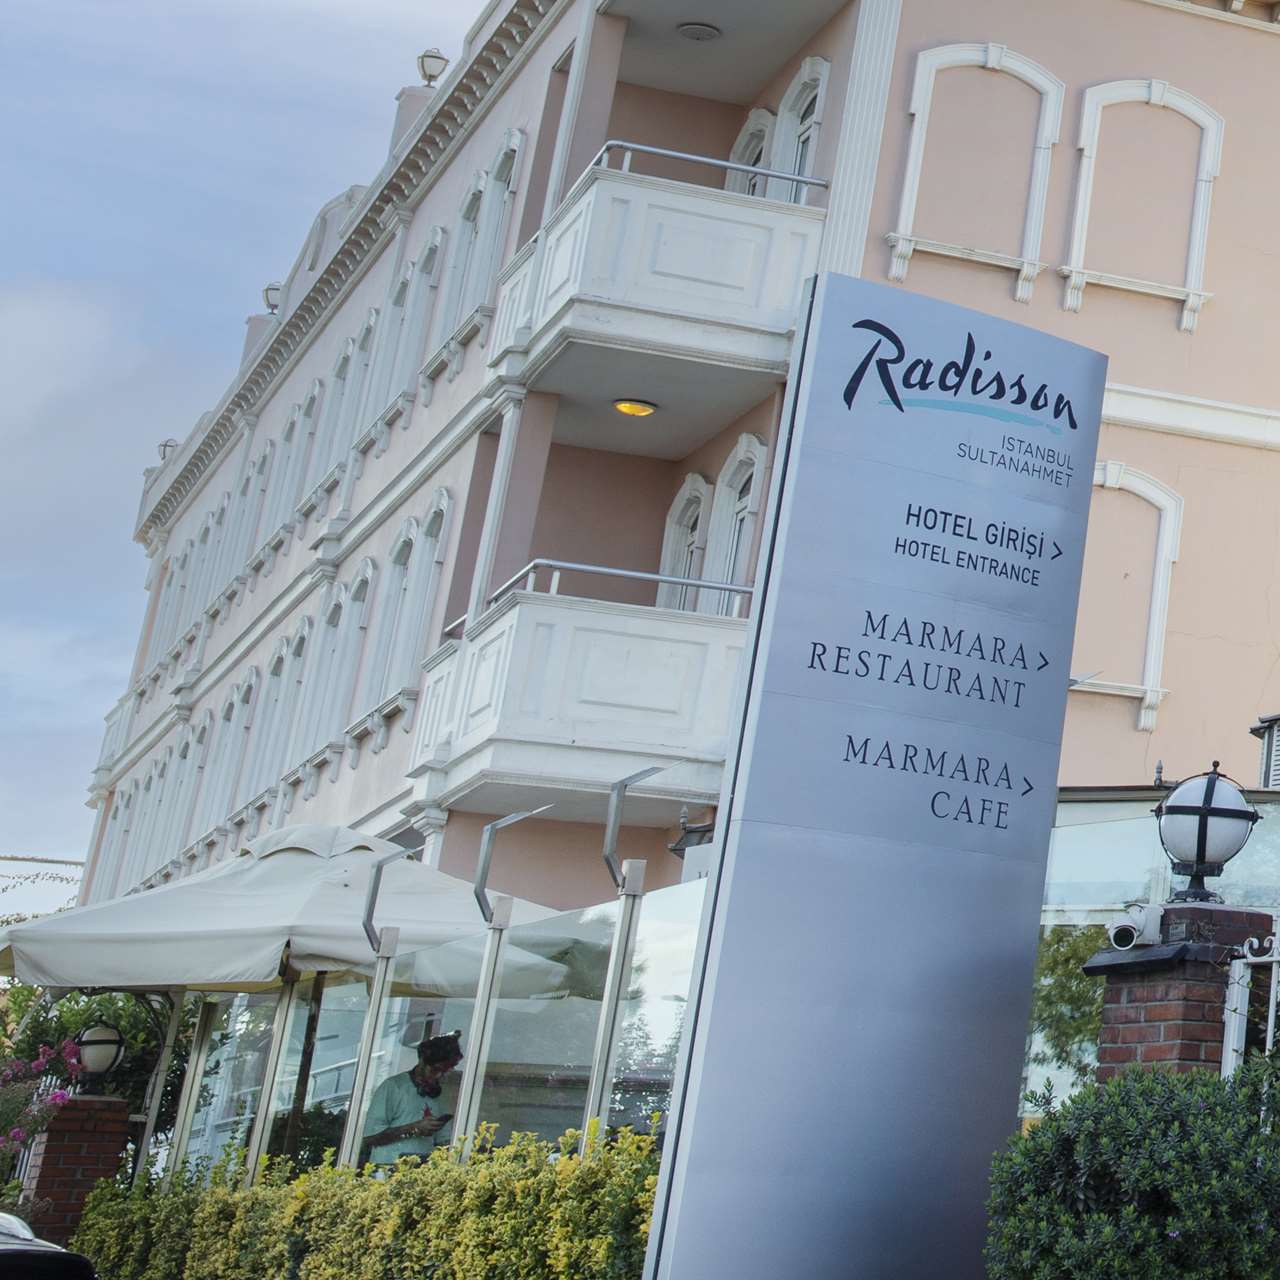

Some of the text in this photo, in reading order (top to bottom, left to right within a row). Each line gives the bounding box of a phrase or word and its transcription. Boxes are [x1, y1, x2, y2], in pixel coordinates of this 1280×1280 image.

[843, 319, 1077, 430] Radisson
[957, 443, 1073, 488] SULTANAHMET
[1002, 435, 1074, 471] ISTANBUL
[906, 504, 1045, 560] HOTEL GİRİŞİ
[895, 537, 1041, 586] HOTEL ENTRANCE
[862, 610, 1029, 671] MARMARA
[808, 642, 1026, 709] RESTAURANT
[843, 735, 1014, 791] MARMARA
[931, 791, 1009, 830] CAFE
